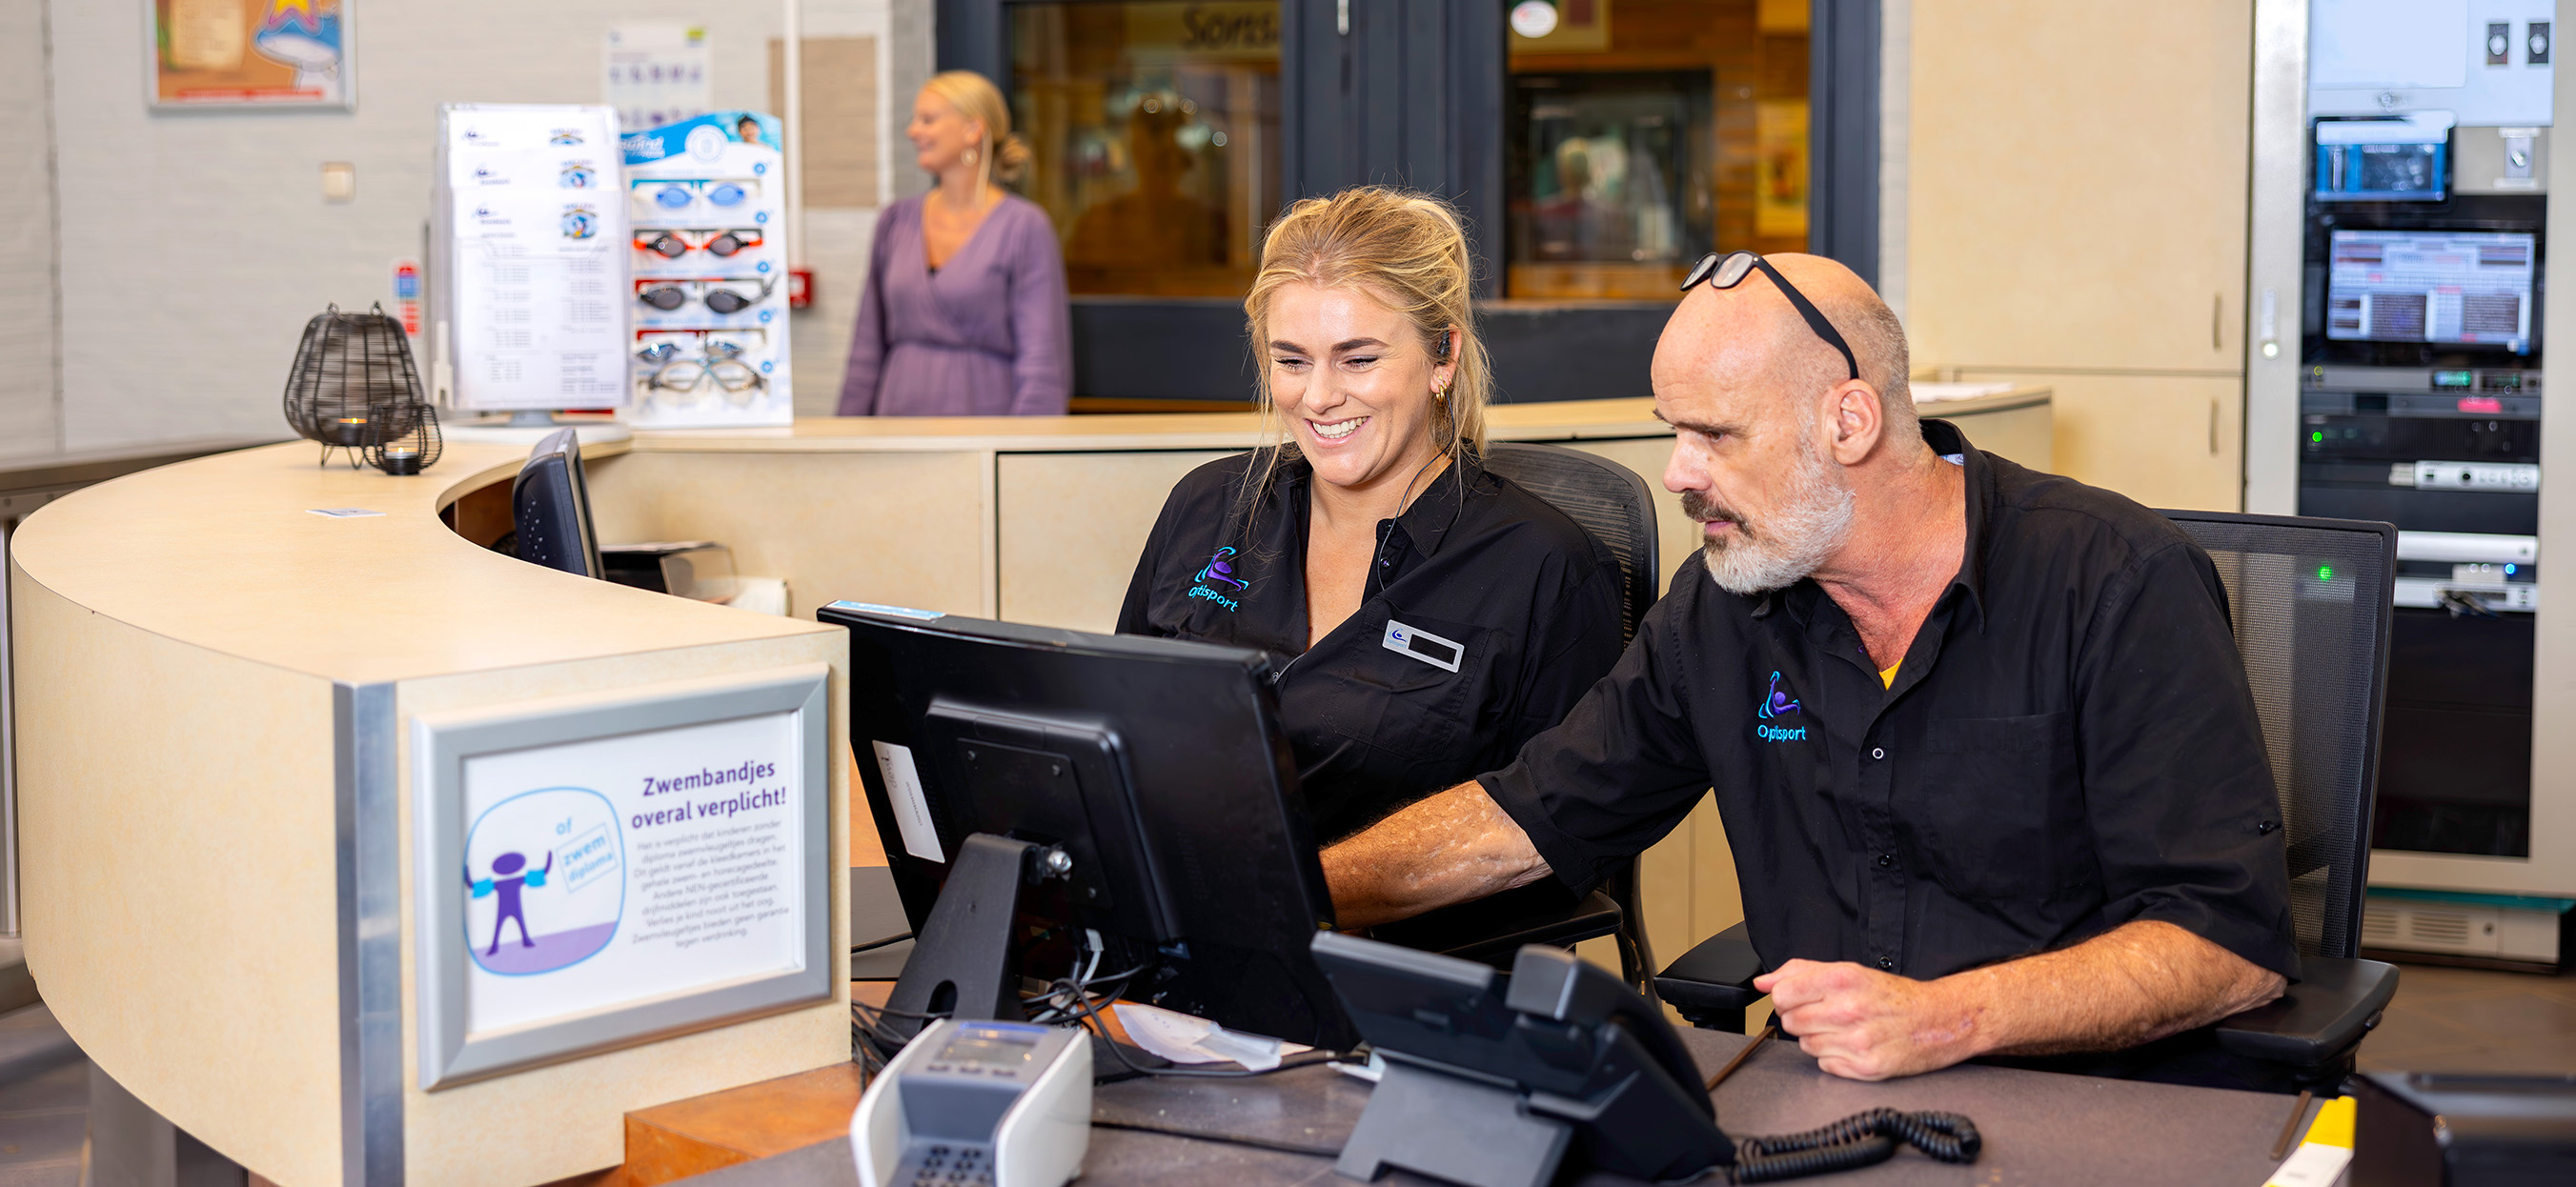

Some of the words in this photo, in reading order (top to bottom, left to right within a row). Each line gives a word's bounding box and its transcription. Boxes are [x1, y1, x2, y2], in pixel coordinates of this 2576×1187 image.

[642, 761, 775, 796] Zwembandjes
[632, 801, 692, 829] overal
[698, 787, 786, 817] verplicht!
[556, 816, 572, 835] of
[564, 835, 606, 866] zwem
[569, 853, 613, 882] diploma
